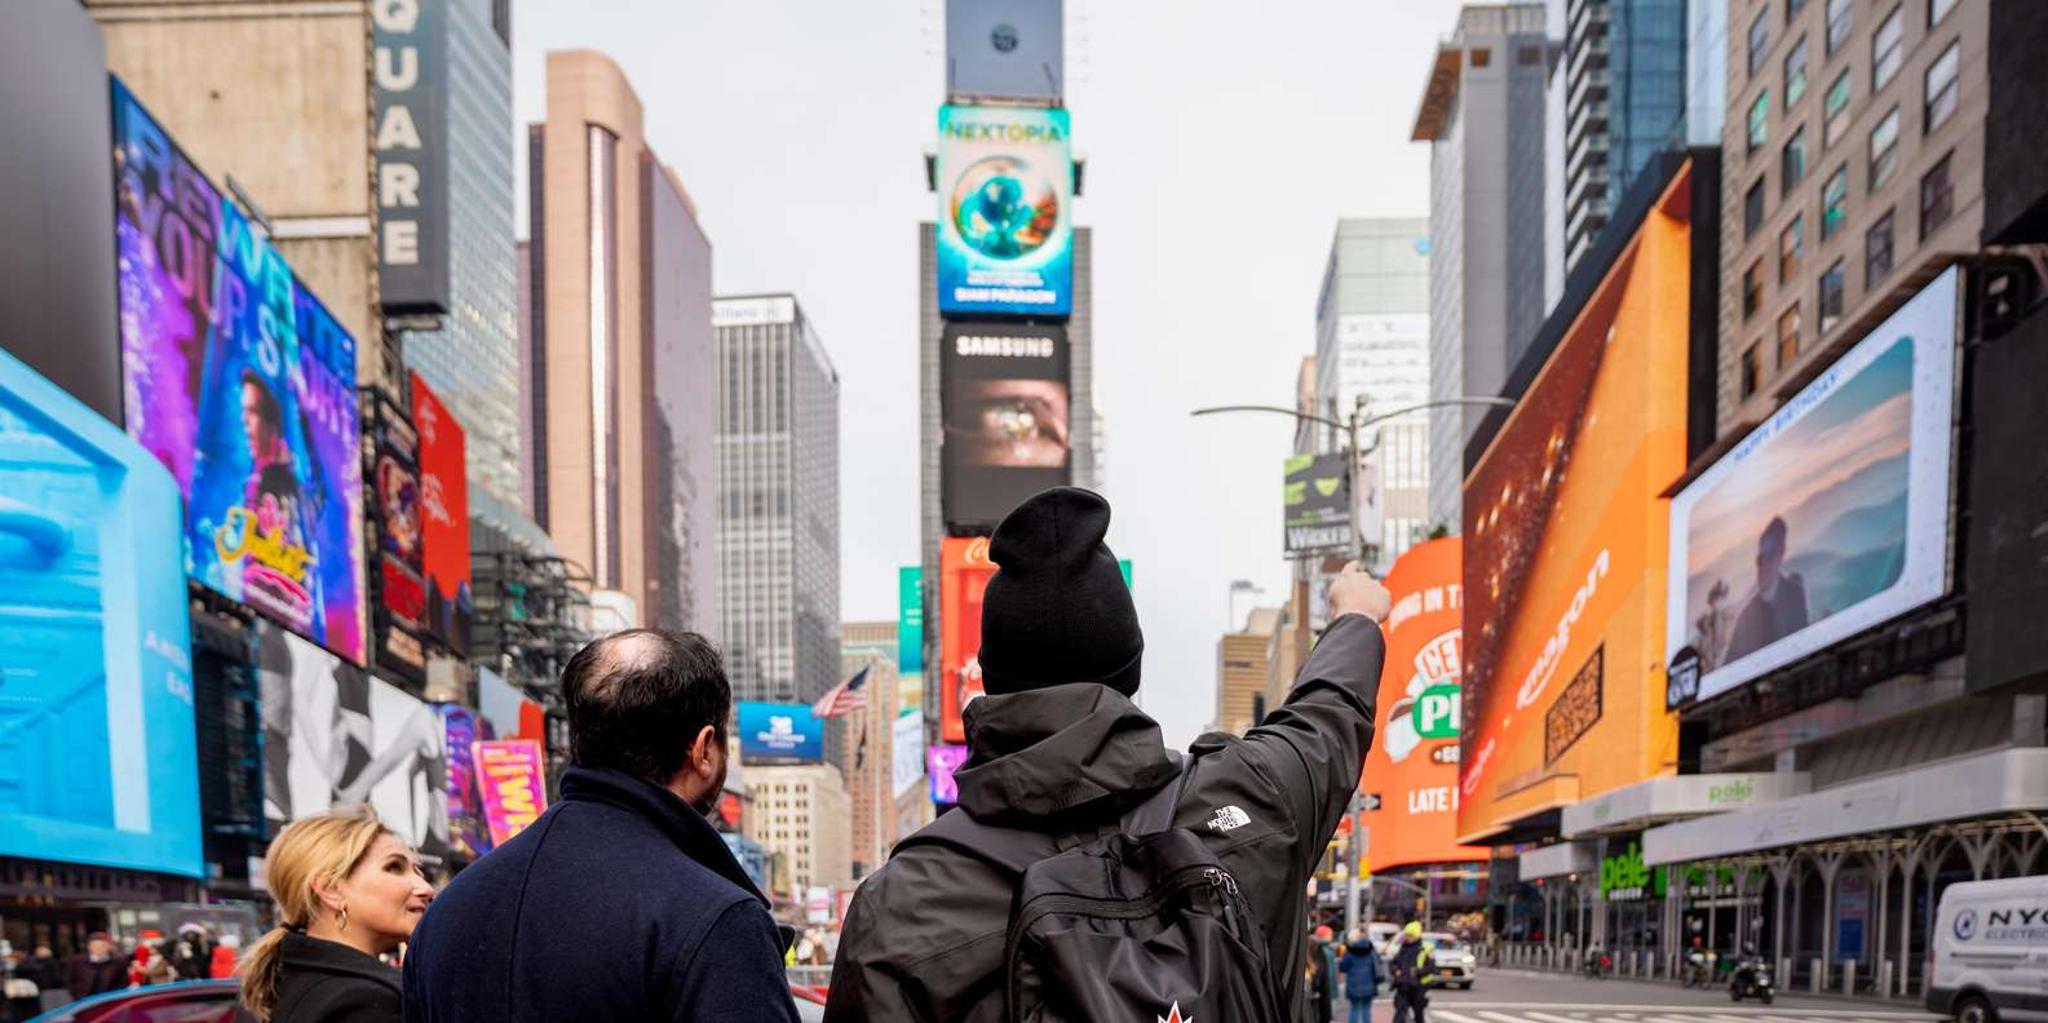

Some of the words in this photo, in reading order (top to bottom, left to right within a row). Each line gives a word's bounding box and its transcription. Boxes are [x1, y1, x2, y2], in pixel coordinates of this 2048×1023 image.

[946, 121, 1063, 144] NEXTOPIA
[956, 336, 1054, 358] SAMSUNG
[1408, 785, 1449, 815] LATE
[1207, 815, 1234, 830] NORTH
